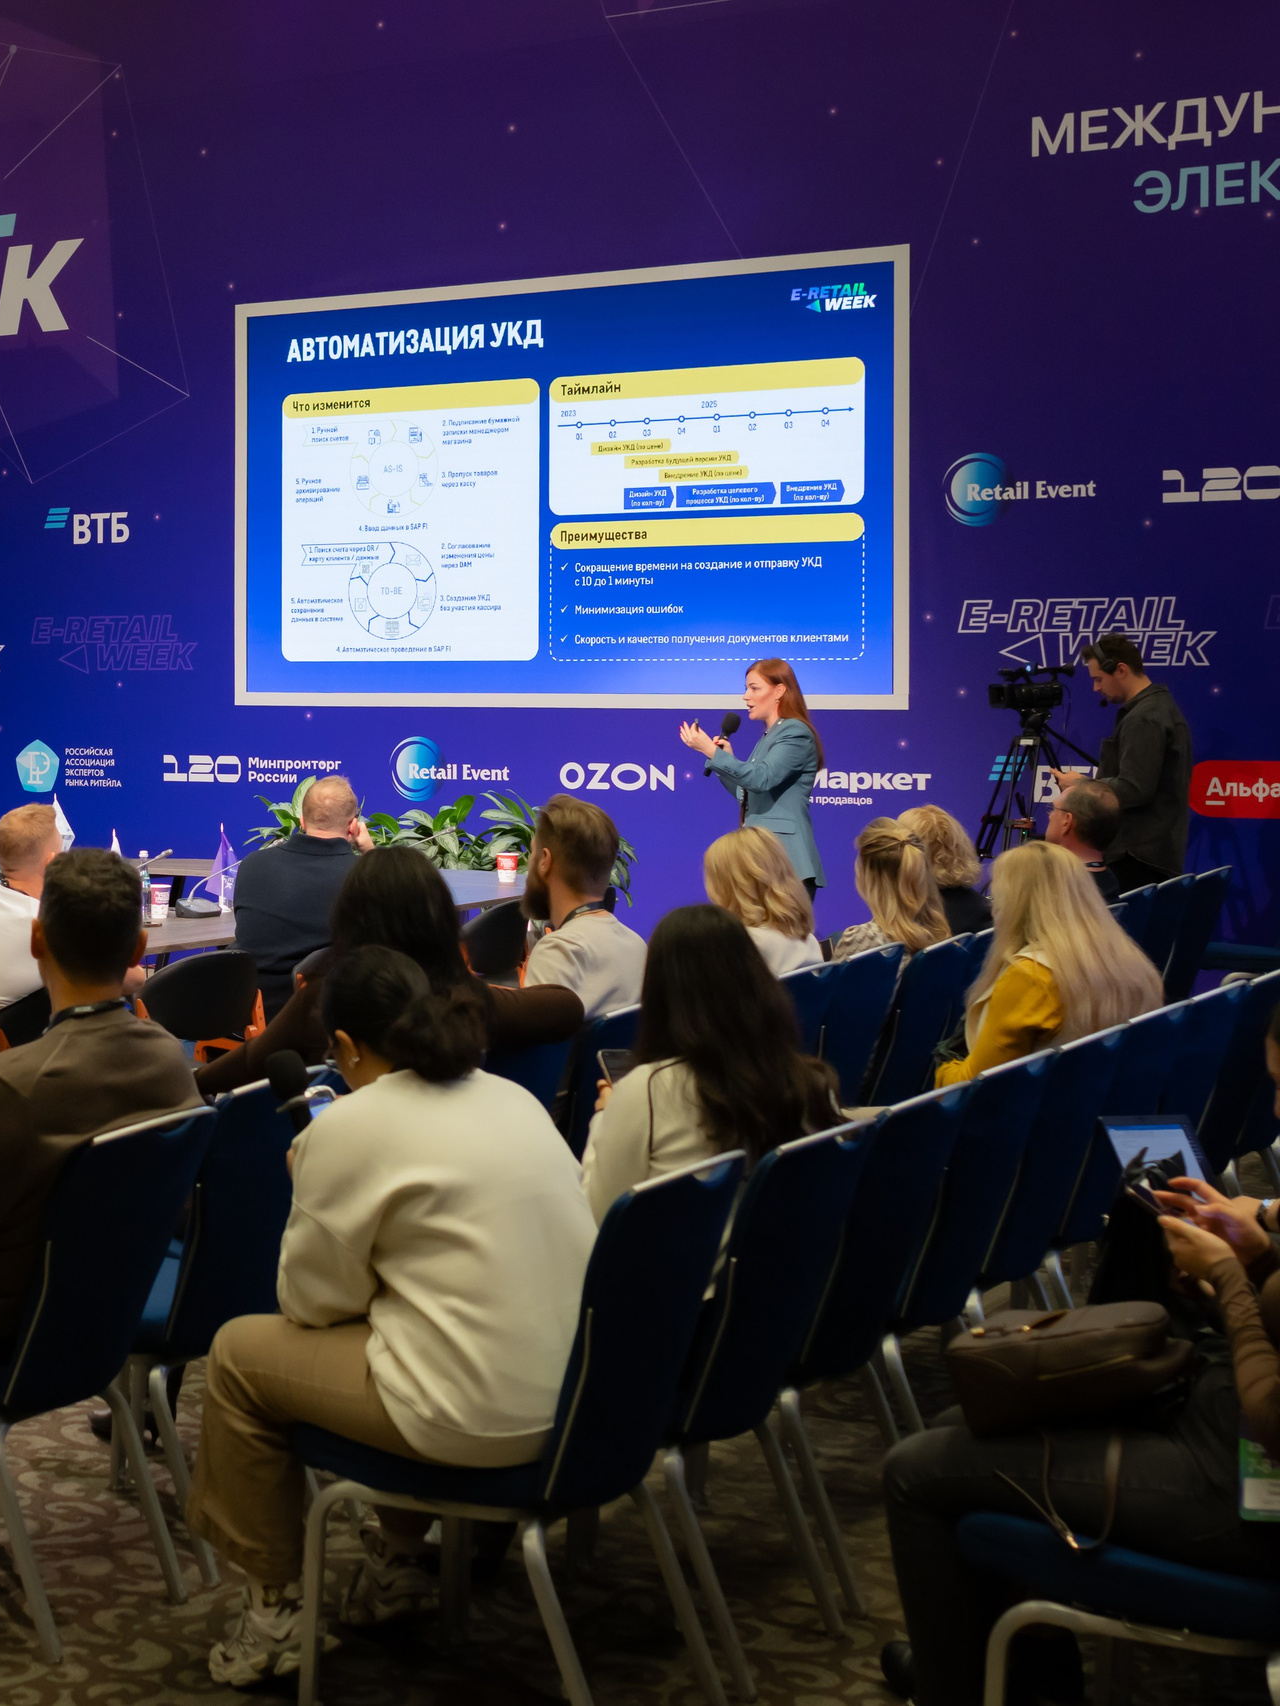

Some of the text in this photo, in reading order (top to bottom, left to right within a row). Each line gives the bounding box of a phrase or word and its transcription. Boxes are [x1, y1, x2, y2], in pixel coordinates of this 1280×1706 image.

[1133, 158, 1280, 214] ЭЛЕК
[790, 282, 868, 302] E-RETAIL
[824, 293, 876, 312] WEEK
[286, 319, 544, 363] АВТОМАТИЗАЦИЯ УКД
[561, 382, 621, 396] Таймлайн
[293, 399, 371, 412] Что изменится
[701, 400, 717, 408] 2025
[561, 409, 577, 417] 2023
[629, 488, 667, 499] Дизайн УКД
[692, 486, 758, 497] Разработка целевого
[786, 482, 837, 493] Внедрение УКД
[967, 480, 1096, 502] Retail Event
[73, 511, 130, 545] ВТБ
[560, 529, 647, 544] Преимущества
[575, 557, 822, 573] Сокращение времени на создание и отправку УКД
[575, 576, 653, 587] с 10 до 1 минуты
[381, 587, 402, 595] TO-BE
[478, 594, 490, 602] УКД
[575, 603, 683, 615] Минимизация ошибок
[958, 597, 1185, 633] E-RETAIL
[31, 615, 178, 644] E-RETAIL
[575, 632, 849, 646] Скорость и качество получения документов клиентами
[97, 642, 198, 671] WEEK
[65, 747, 113, 756] РОССИЙСКАЯ
[65, 758, 115, 767] АССОЦИАЦИЯ
[163, 754, 242, 783] 120
[248, 757, 342, 772] Минпромторг
[65, 768, 104, 777] ЭКСПЕРТОВ
[248, 770, 297, 783] России
[408, 762, 510, 782] Retail Event
[559, 762, 675, 792] OZON
[65, 778, 121, 788] РЫНКА РИТЕЙЛА
[816, 796, 873, 806] продавцов
